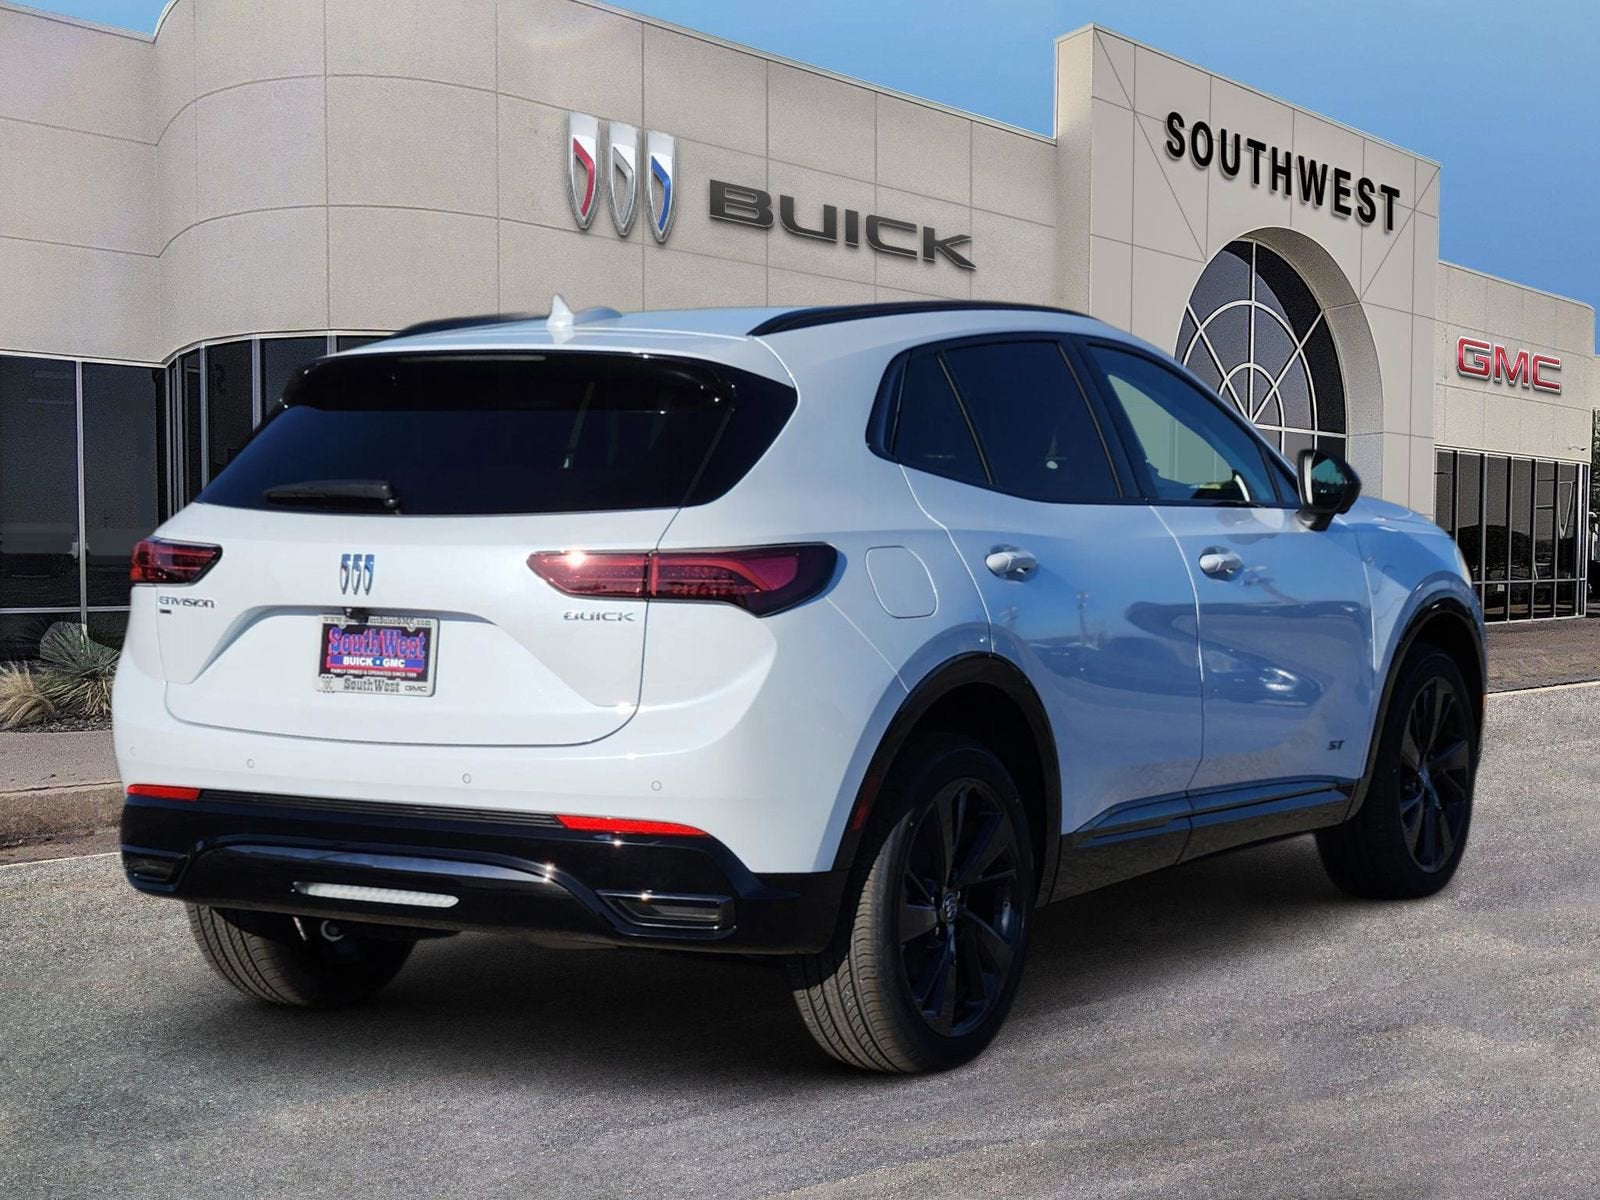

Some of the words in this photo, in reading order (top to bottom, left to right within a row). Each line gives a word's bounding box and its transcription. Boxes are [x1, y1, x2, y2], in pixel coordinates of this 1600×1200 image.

[1166, 111, 1400, 232] SOUTHWEST
[709, 179, 977, 270] BUICK
[1457, 336, 1561, 394] GMC
[563, 611, 635, 622] BUICK
[343, 656, 373, 667] BUICK
[383, 658, 406, 668] GMC
[1328, 740, 1345, 750] ST
